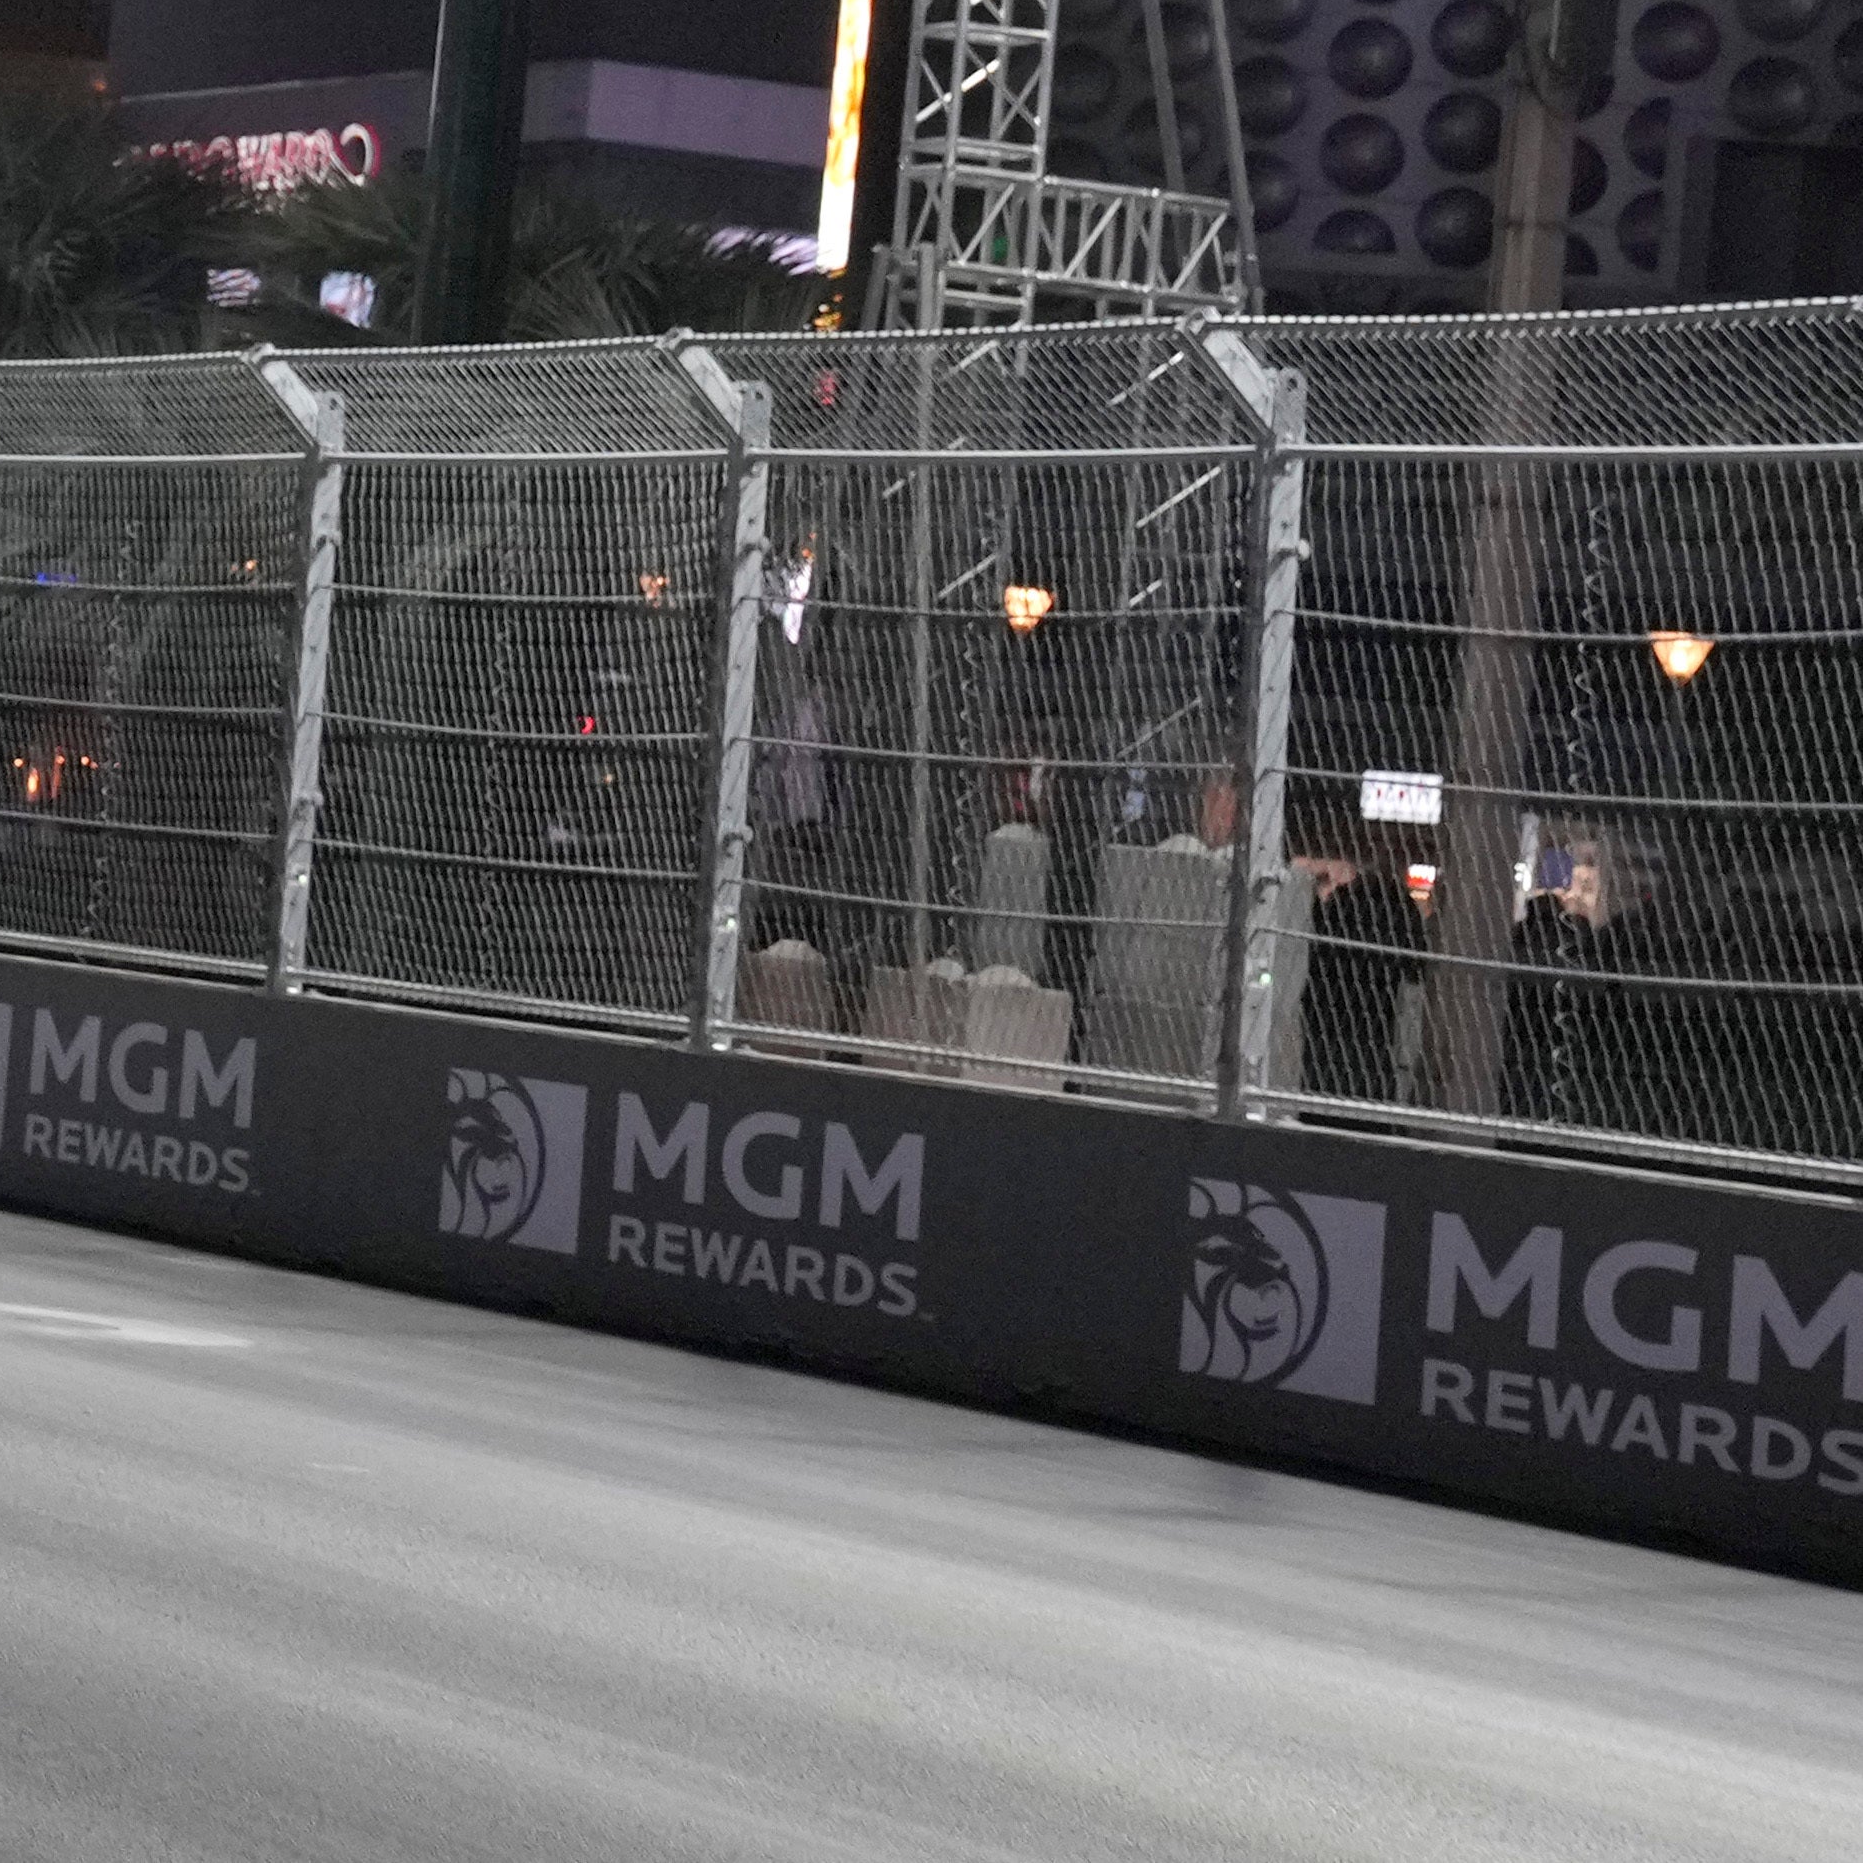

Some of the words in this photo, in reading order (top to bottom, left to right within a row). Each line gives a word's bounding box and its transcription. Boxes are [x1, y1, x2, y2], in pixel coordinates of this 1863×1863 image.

[28, 1007, 257, 1129] MGM
[23, 1113, 251, 1195] REWARDS
[612, 1091, 925, 1242] MGM
[608, 1211, 920, 1319] REWARDS
[1425, 1210, 1863, 1402] MGM
[1420, 1357, 1863, 1496] REWARDS
